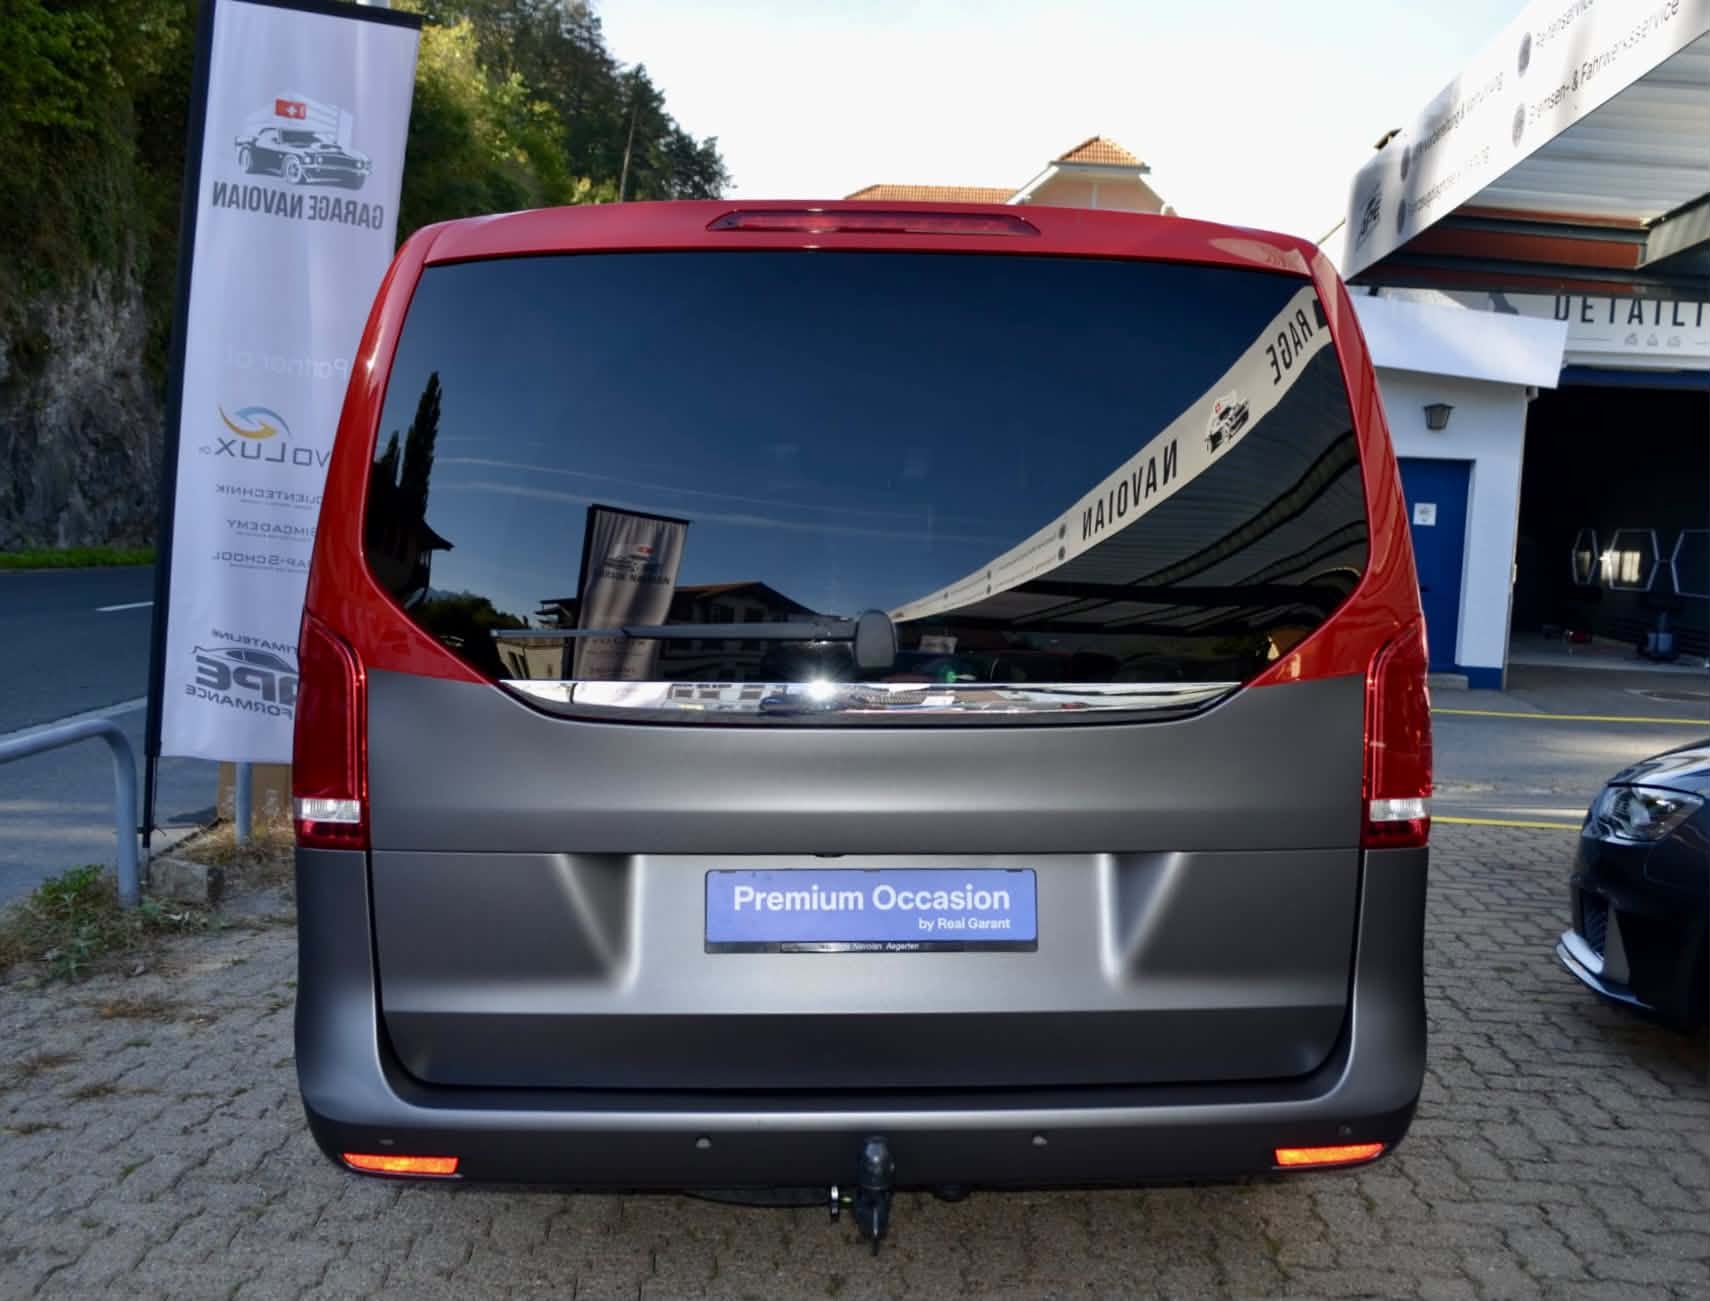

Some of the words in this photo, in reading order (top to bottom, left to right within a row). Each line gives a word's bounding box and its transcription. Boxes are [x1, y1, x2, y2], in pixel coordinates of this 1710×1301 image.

[733, 884, 864, 911] Premium
[872, 884, 1010, 911] Occasion
[918, 918, 934, 932] by
[937, 918, 965, 929] Real
[968, 918, 1011, 929] Garant
